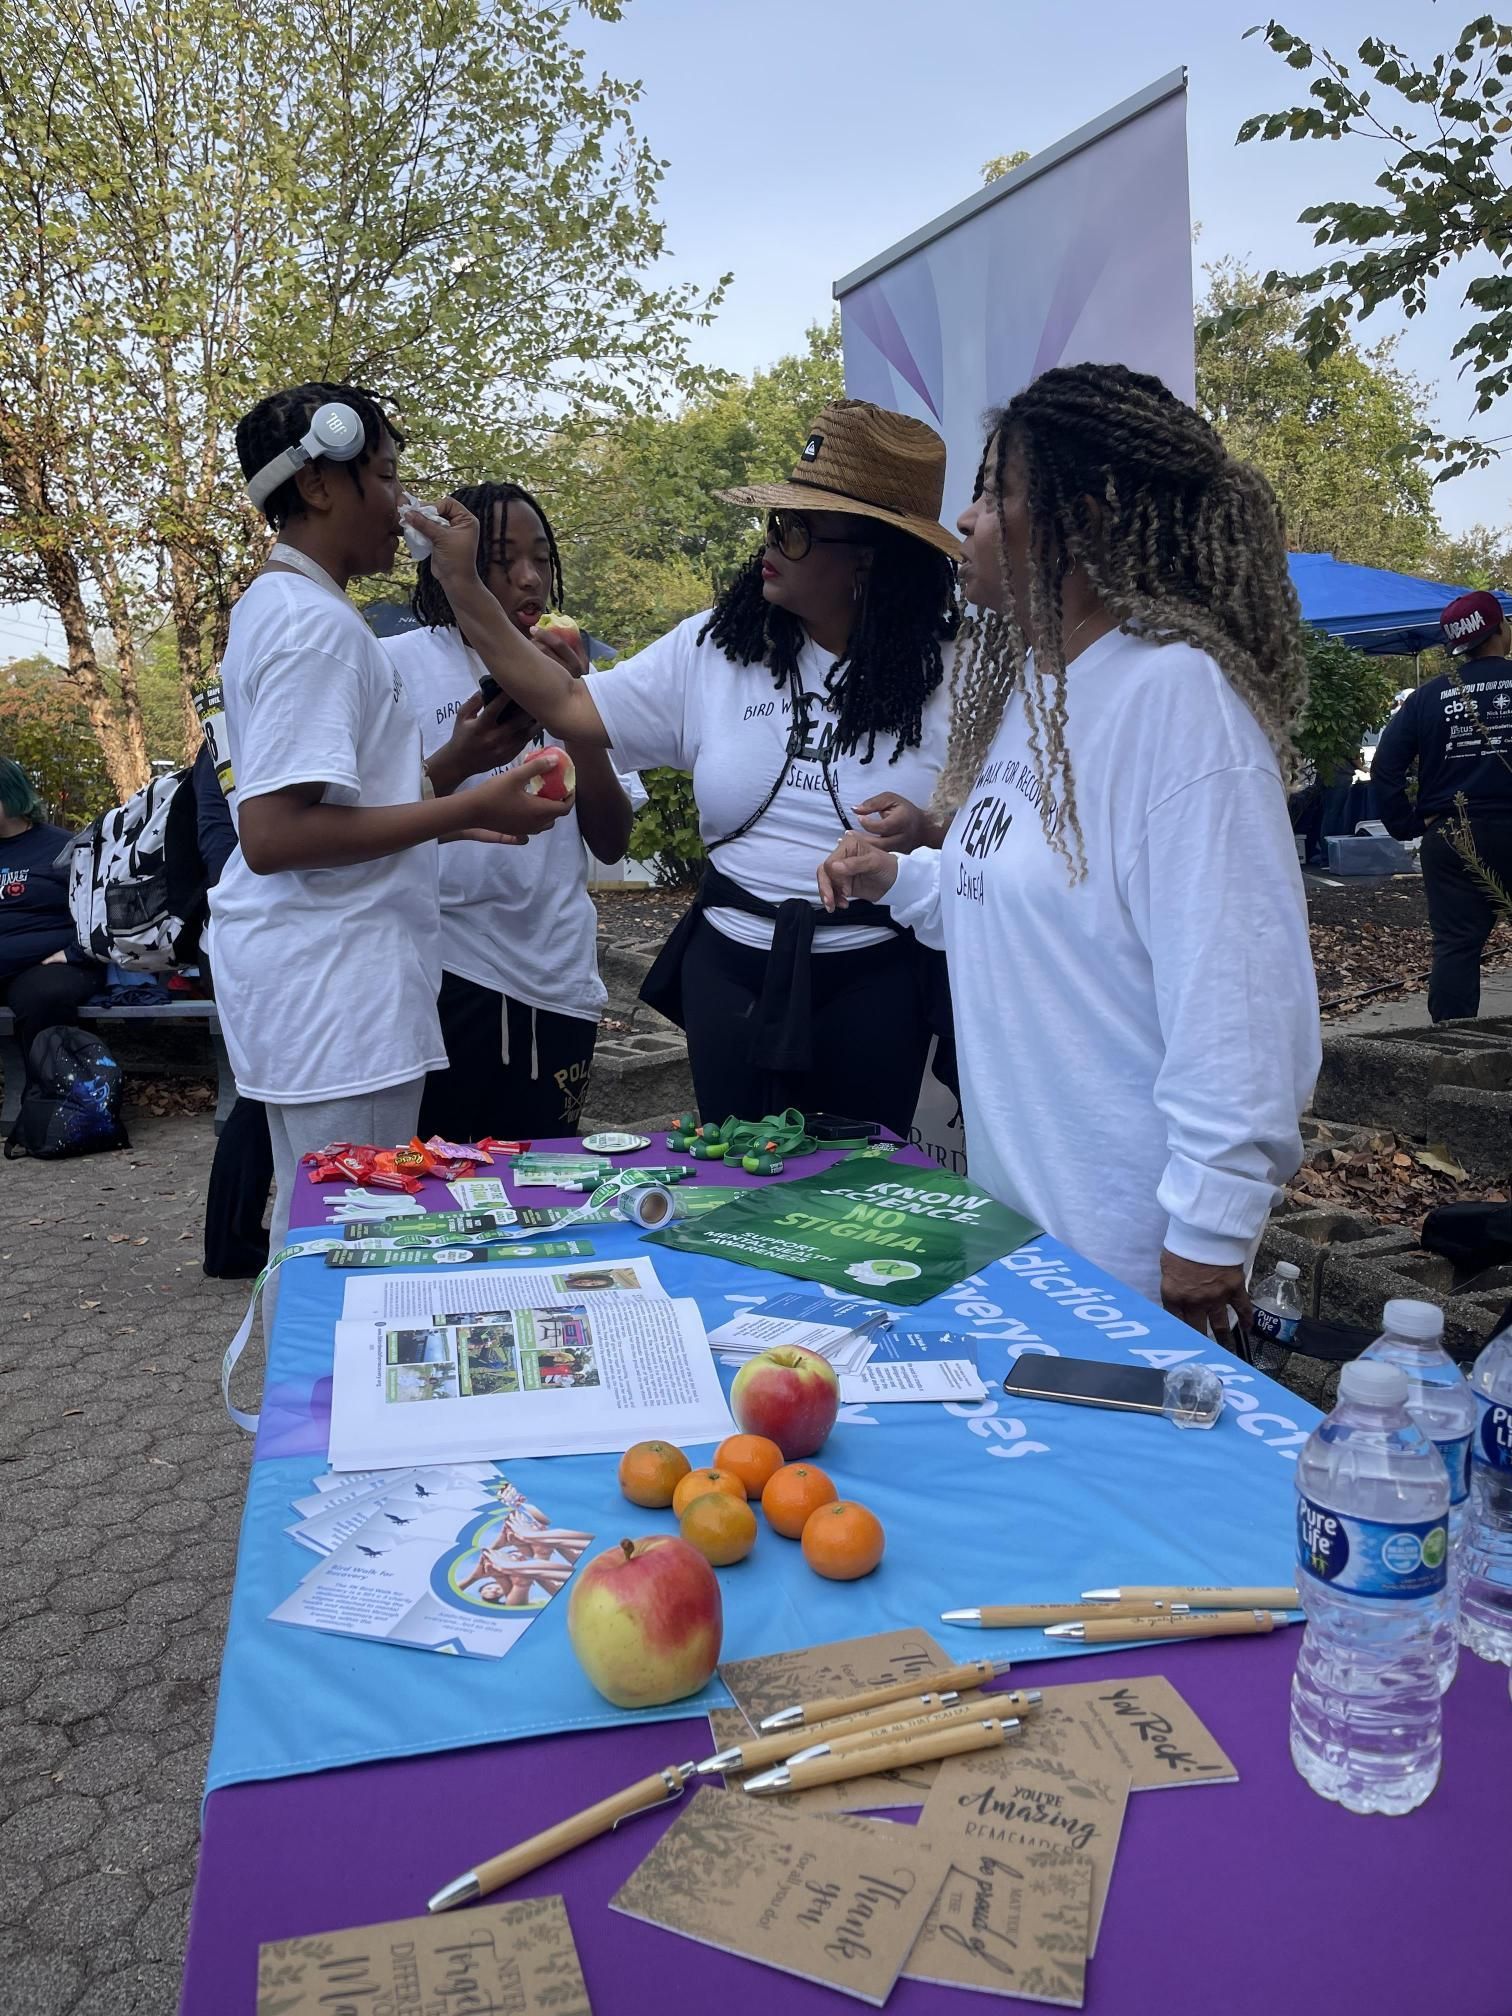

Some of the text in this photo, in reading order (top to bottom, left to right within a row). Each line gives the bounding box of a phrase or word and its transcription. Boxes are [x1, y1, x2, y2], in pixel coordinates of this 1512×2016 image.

[329, 412, 348, 435] JBL
[1476, 682, 1485, 692] TO
[1485, 680, 1498, 691] OUR
[1498, 678, 1512, 690] SPON
[435, 700, 462, 725] BIRD
[743, 702, 775, 721] BIRD
[786, 764, 840, 793] SENECA
[975, 760, 1059, 836] WALK FOR RECOVRY
[960, 796, 1013, 859] TEAM
[956, 861, 985, 906] SENECA
[820, 1188, 980, 1226] SCIENCE.
[868, 1182, 991, 1210] KNOW
[843, 1204, 907, 1229] NO
[703, 1230, 837, 1263] MENTAL HEALTH
[741, 1231, 820, 1252] SUPPORT
[773, 1212, 927, 1253] STIGMA.
[706, 1238, 812, 1264] AWARENESS
[941, 1275, 1060, 1358] Everyo
[1257, 1310, 1279, 1325] Pure
[1257, 1318, 1274, 1331] Life
[999, 1247, 1312, 1460] diction Affect
[1493, 1407, 1512, 1433] Pu
[1496, 1426, 1512, 1448] Li
[1300, 1497, 1337, 1536] Pure
[1301, 1521, 1332, 1555] Life
[326, 1570, 369, 1580] Recovery
[352, 1566, 378, 1575] Walk
[869, 1726, 889, 1738] FOR
[890, 1723, 906, 1733] ALL
[908, 1715, 932, 1728] THAT
[932, 1710, 953, 1721] YOU
[1013, 1785, 1065, 1808] YOU'RE
[958, 1786, 1103, 1850] Amazing
[799, 1851, 817, 1872] for
[787, 1868, 803, 1887] all
[771, 1879, 792, 1908] you
[796, 1879, 841, 1931] you
[823, 1867, 916, 1963] Thank
[940, 1856, 1024, 1976] be proud of
[318, 1956, 381, 2016] Ma
[390, 1941, 422, 2016] DIFFERE
[497, 1957, 526, 2016] NEVER
[371, 1990, 394, 2016] YO
[425, 1999, 448, 2016] TH
